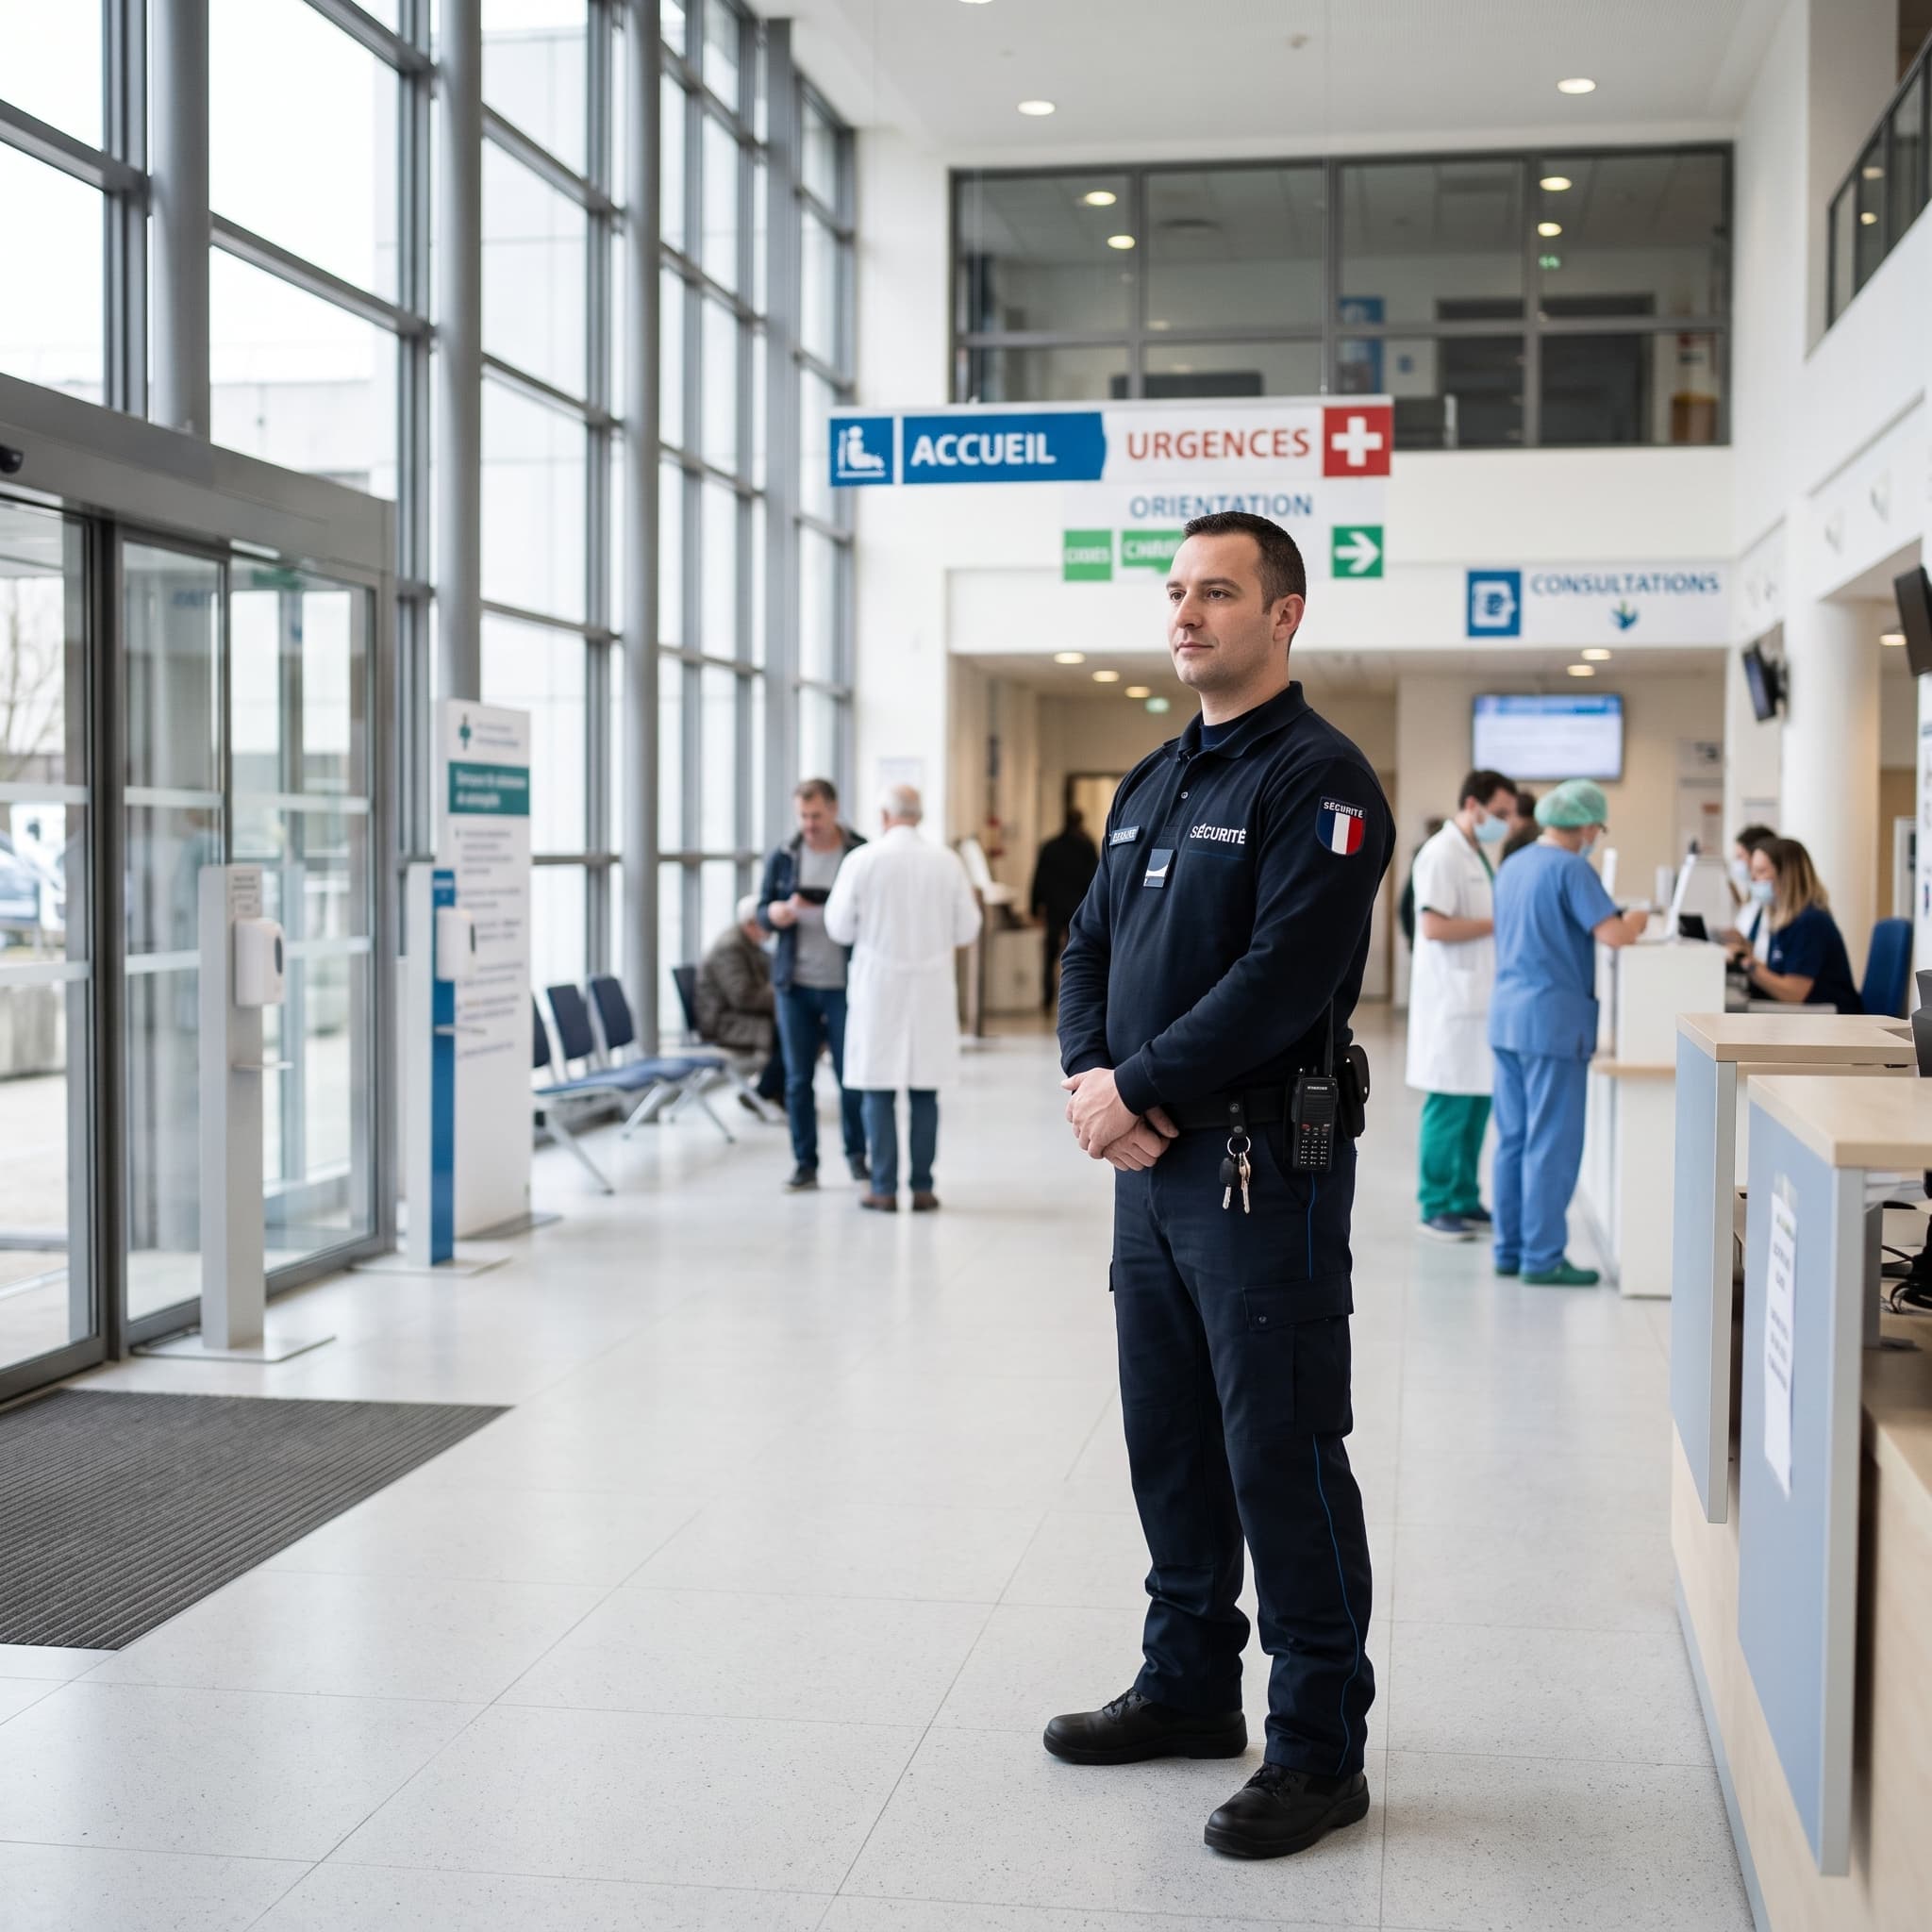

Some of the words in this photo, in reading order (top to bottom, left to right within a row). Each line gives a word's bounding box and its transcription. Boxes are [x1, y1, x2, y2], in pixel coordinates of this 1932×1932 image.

[910, 433, 1057, 466] ACCUEIL
[1126, 428, 1310, 459] URGENCES
[1130, 494, 1312, 518] ORIENTATION
[1530, 573, 1720, 595] CONSULTATIONS
[1190, 823, 1246, 844] SÉCURITÉ
